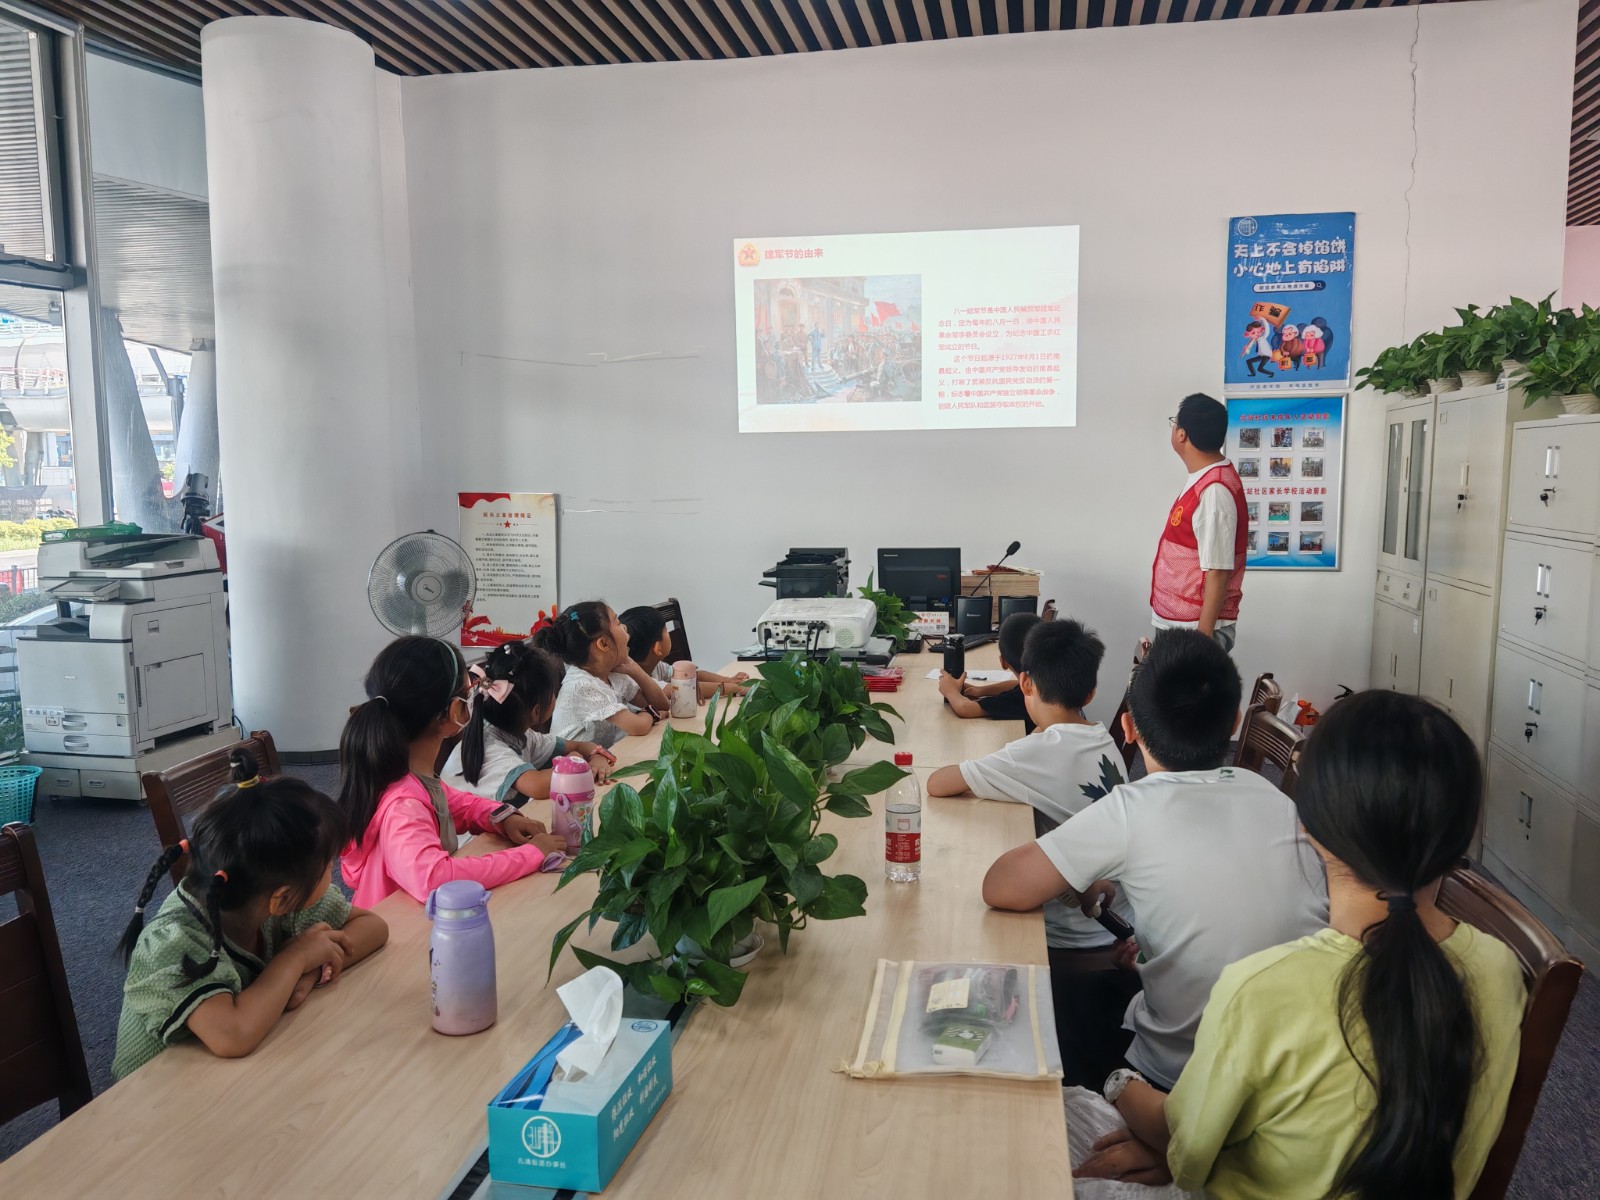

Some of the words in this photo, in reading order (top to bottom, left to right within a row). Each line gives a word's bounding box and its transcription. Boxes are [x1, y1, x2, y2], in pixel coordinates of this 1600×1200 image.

[765, 248, 824, 259] 建军节的由来
[1234, 239, 1346, 258] 天上不会掉馅饼
[1233, 259, 1346, 277] 小心地上有陷阱
